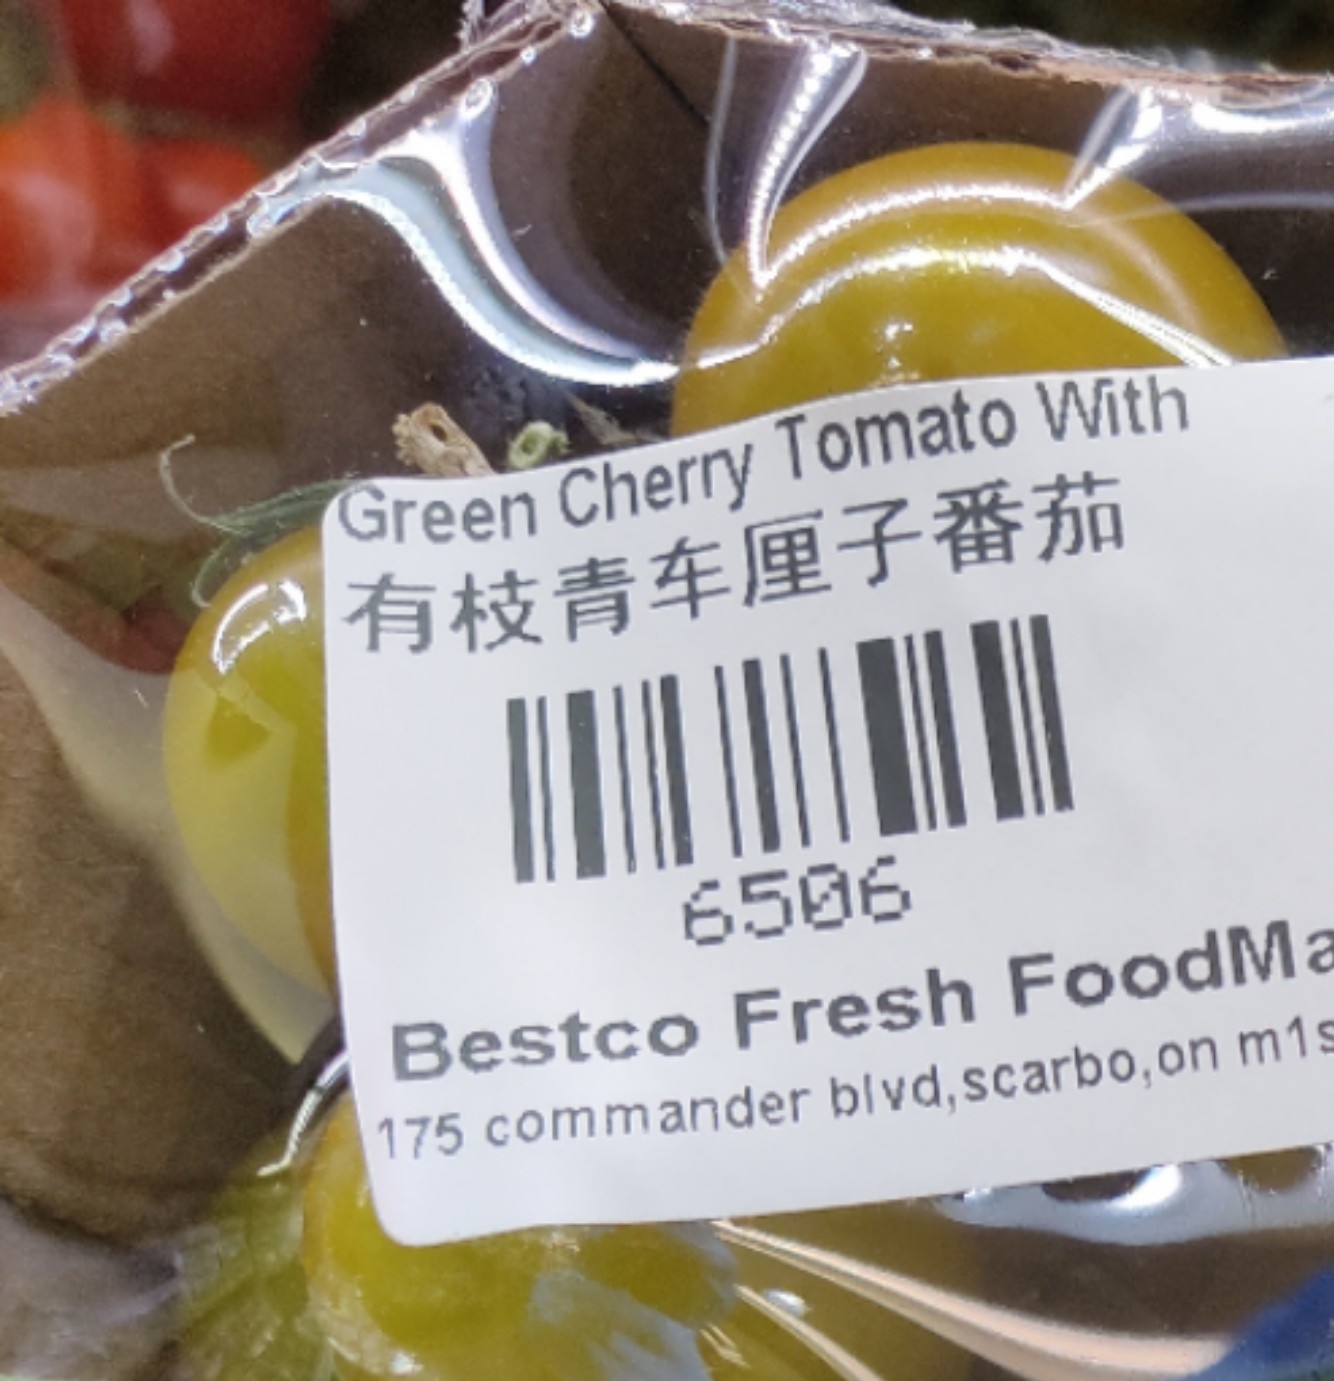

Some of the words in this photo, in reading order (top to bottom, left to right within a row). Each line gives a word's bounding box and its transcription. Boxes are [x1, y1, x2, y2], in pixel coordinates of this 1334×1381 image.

[338, 484, 538, 542] Green
[559, 442, 754, 527] Cherry
[774, 388, 1017, 480] Tomato
[1036, 374, 1189, 441] With
[343, 471, 1124, 654] 有枝青车厘子番茄
[682, 855, 912, 946] 6506
[391, 1010, 699, 1081] Bestco
[734, 967, 975, 1050] Fresh
[377, 1112, 464, 1160] 175
[486, 1085, 811, 1147] commander
